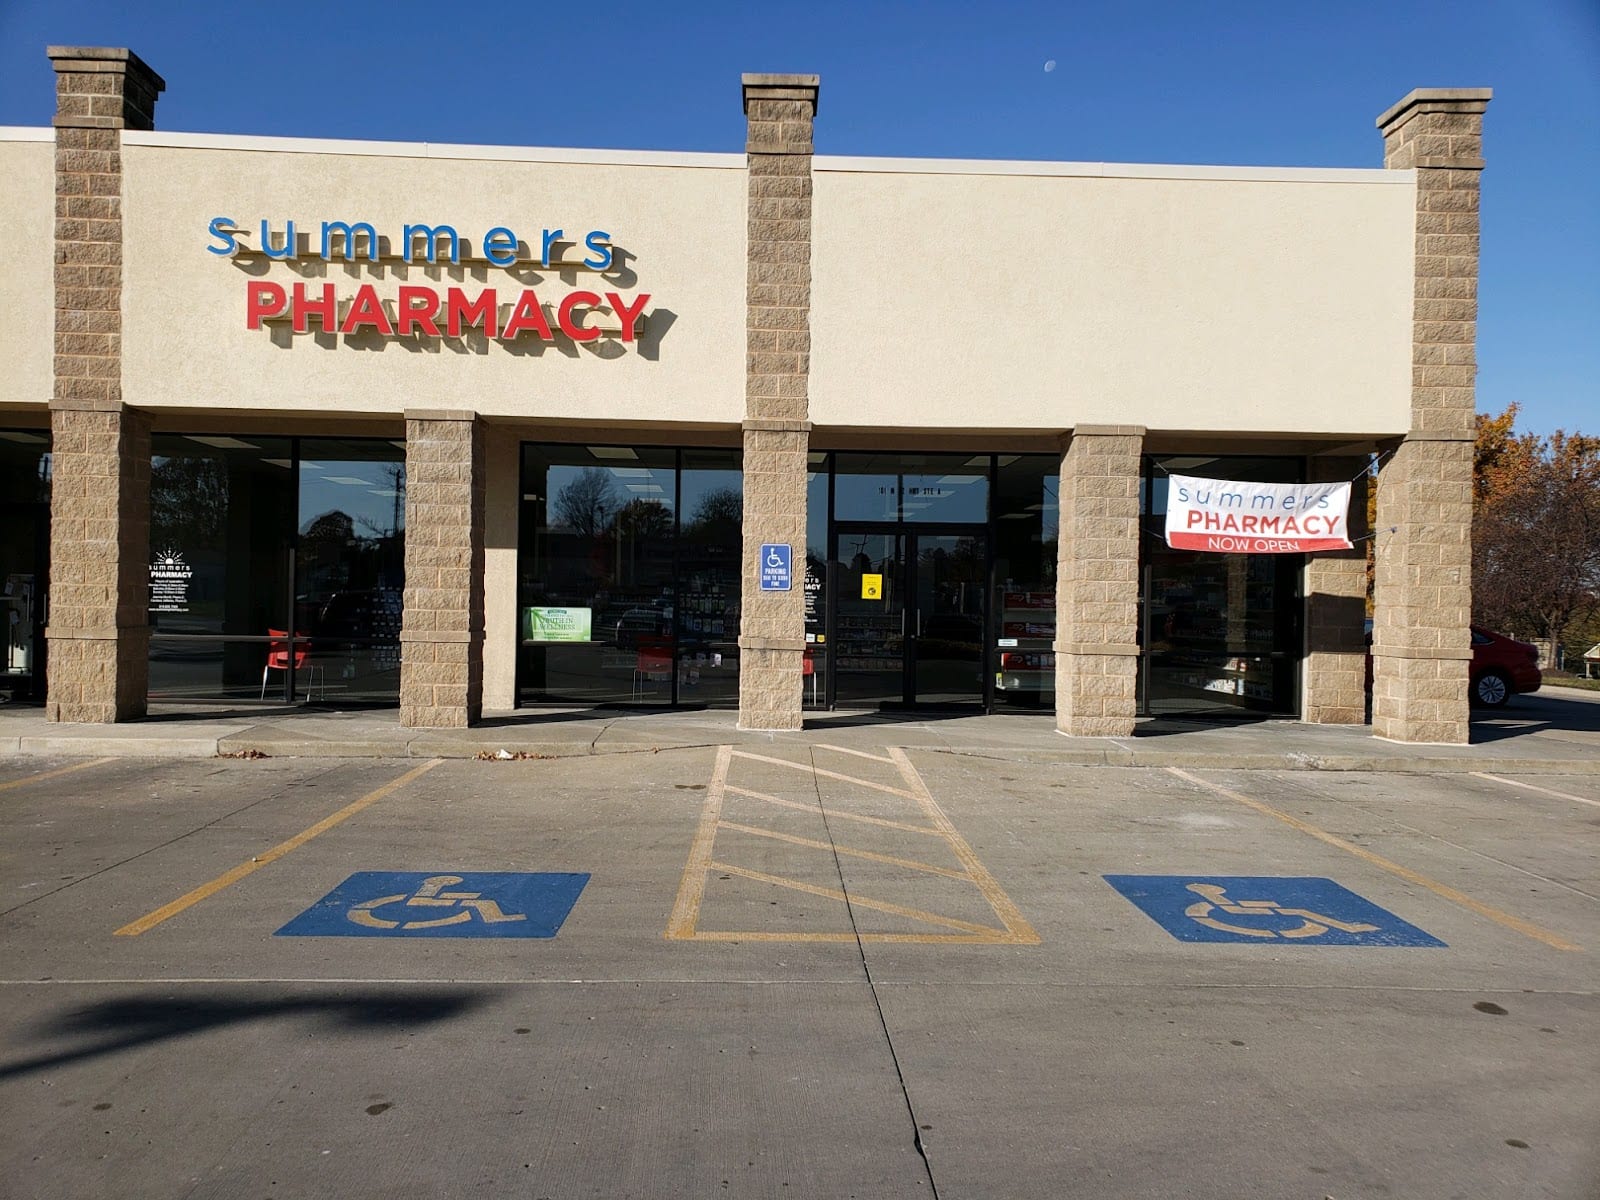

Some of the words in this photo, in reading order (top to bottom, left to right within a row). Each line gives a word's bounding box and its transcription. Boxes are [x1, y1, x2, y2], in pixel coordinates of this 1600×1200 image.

[206, 216, 614, 269] summers
[247, 280, 652, 343] PHARMACY
[1178, 487, 1329, 510] summers
[1187, 509, 1340, 535] PHARMACY
[1208, 536, 1250, 550] NOW
[1254, 539, 1299, 551] OPEN
